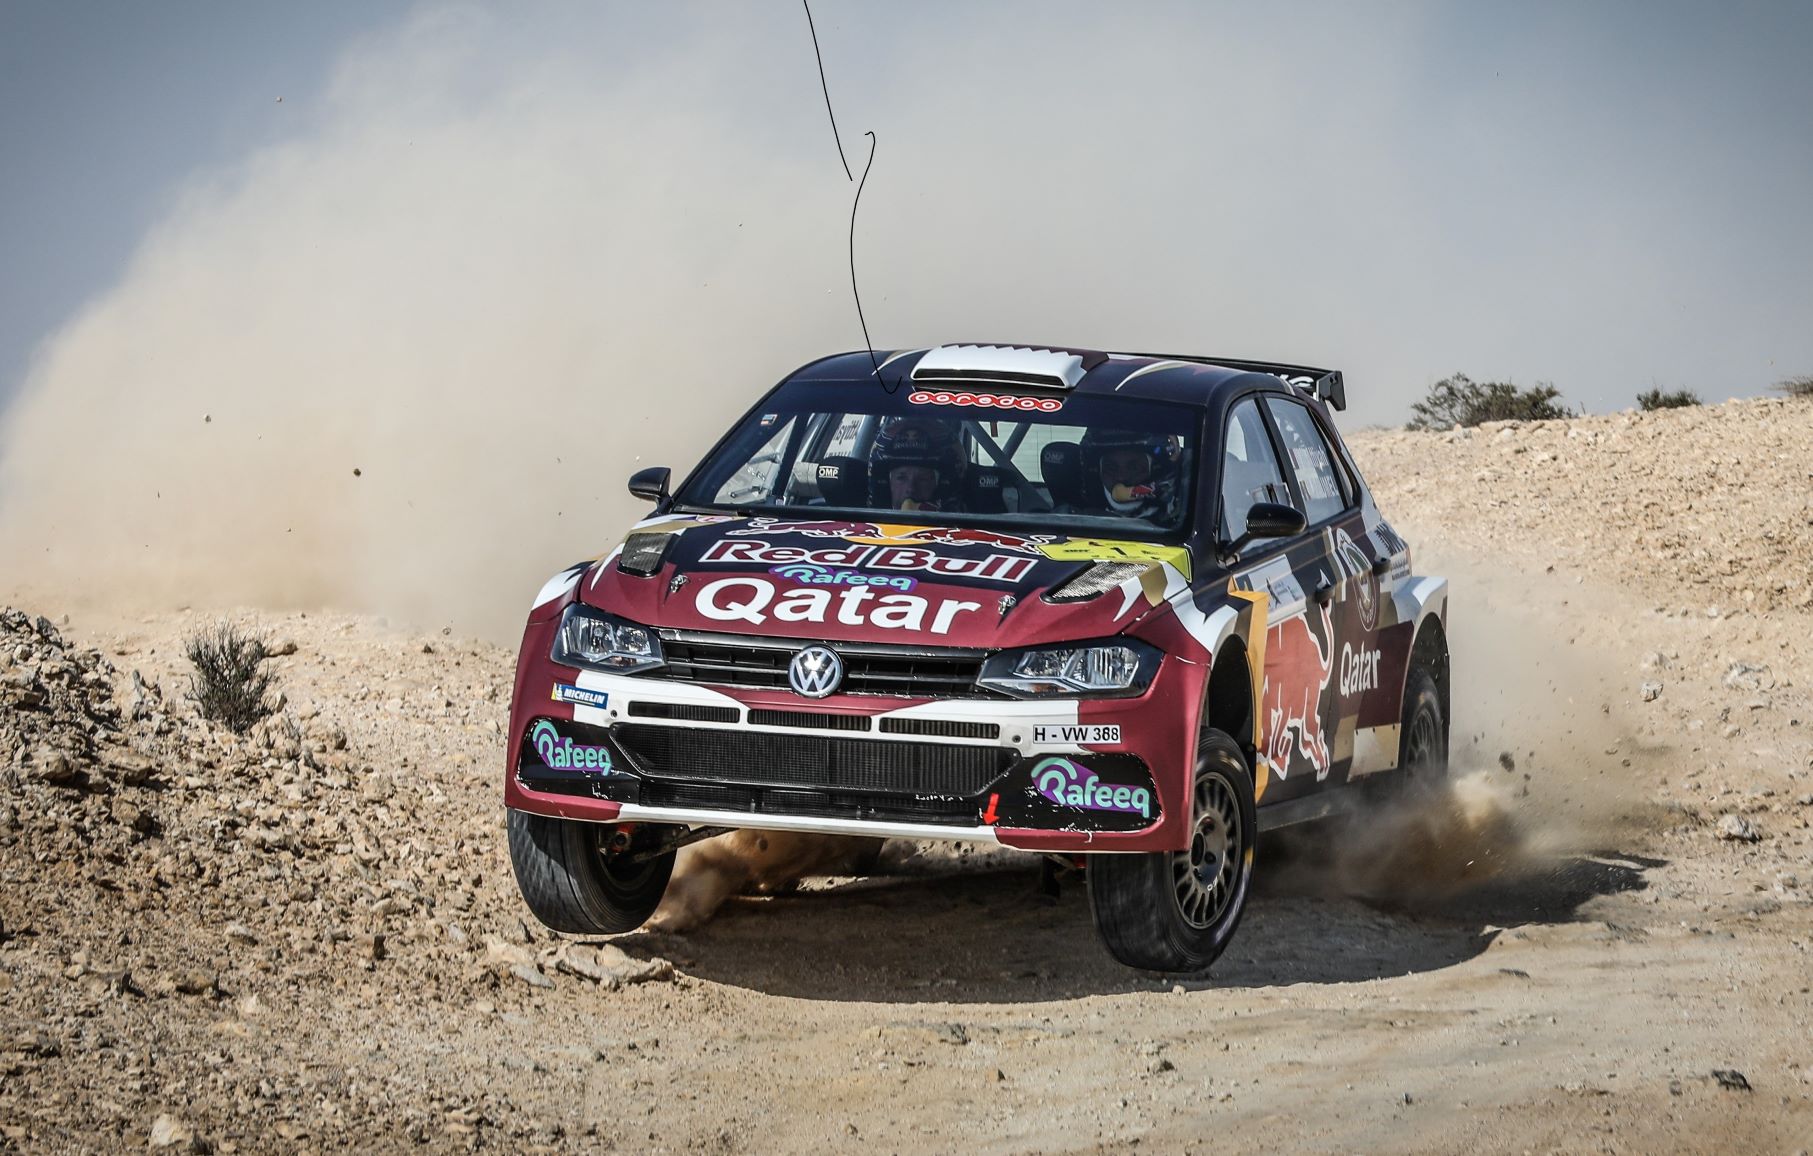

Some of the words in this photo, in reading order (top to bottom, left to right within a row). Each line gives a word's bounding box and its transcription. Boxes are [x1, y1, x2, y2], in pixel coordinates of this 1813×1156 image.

[911, 393, 1060, 412] ooredoo
[818, 467, 840, 478] OMP
[699, 540, 877, 567] Red
[865, 547, 1040, 583] Bull
[774, 564, 912, 591] Rafeeq
[695, 577, 982, 634] Qatar
[1340, 640, 1381, 698] Qatar
[563, 688, 606, 704] MICHELIN
[533, 720, 612, 776] Rafeeq
[1034, 727, 1046, 742] H
[1062, 727, 1089, 742] VW
[1031, 758, 1150, 818] Rafeeq
